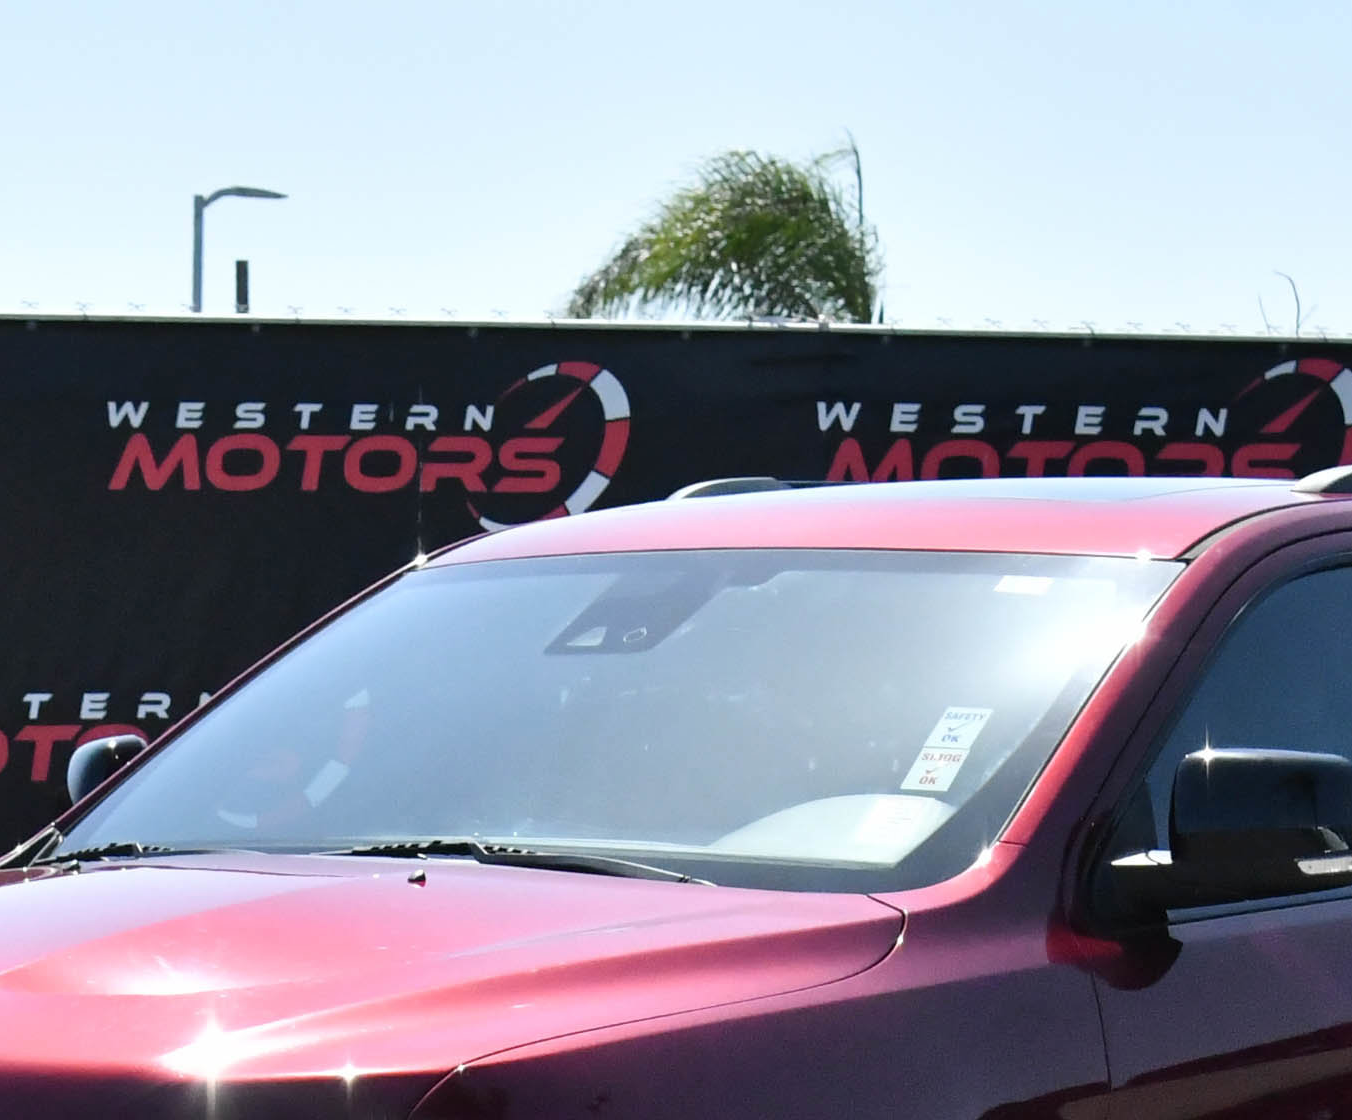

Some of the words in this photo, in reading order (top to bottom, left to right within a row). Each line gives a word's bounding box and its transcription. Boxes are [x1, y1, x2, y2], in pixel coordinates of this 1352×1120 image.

[106, 400, 495, 431] WESTERN
[815, 401, 1228, 437] WESTERN
[108, 433, 565, 493] MOTORS
[918, 775, 938, 785] OK
